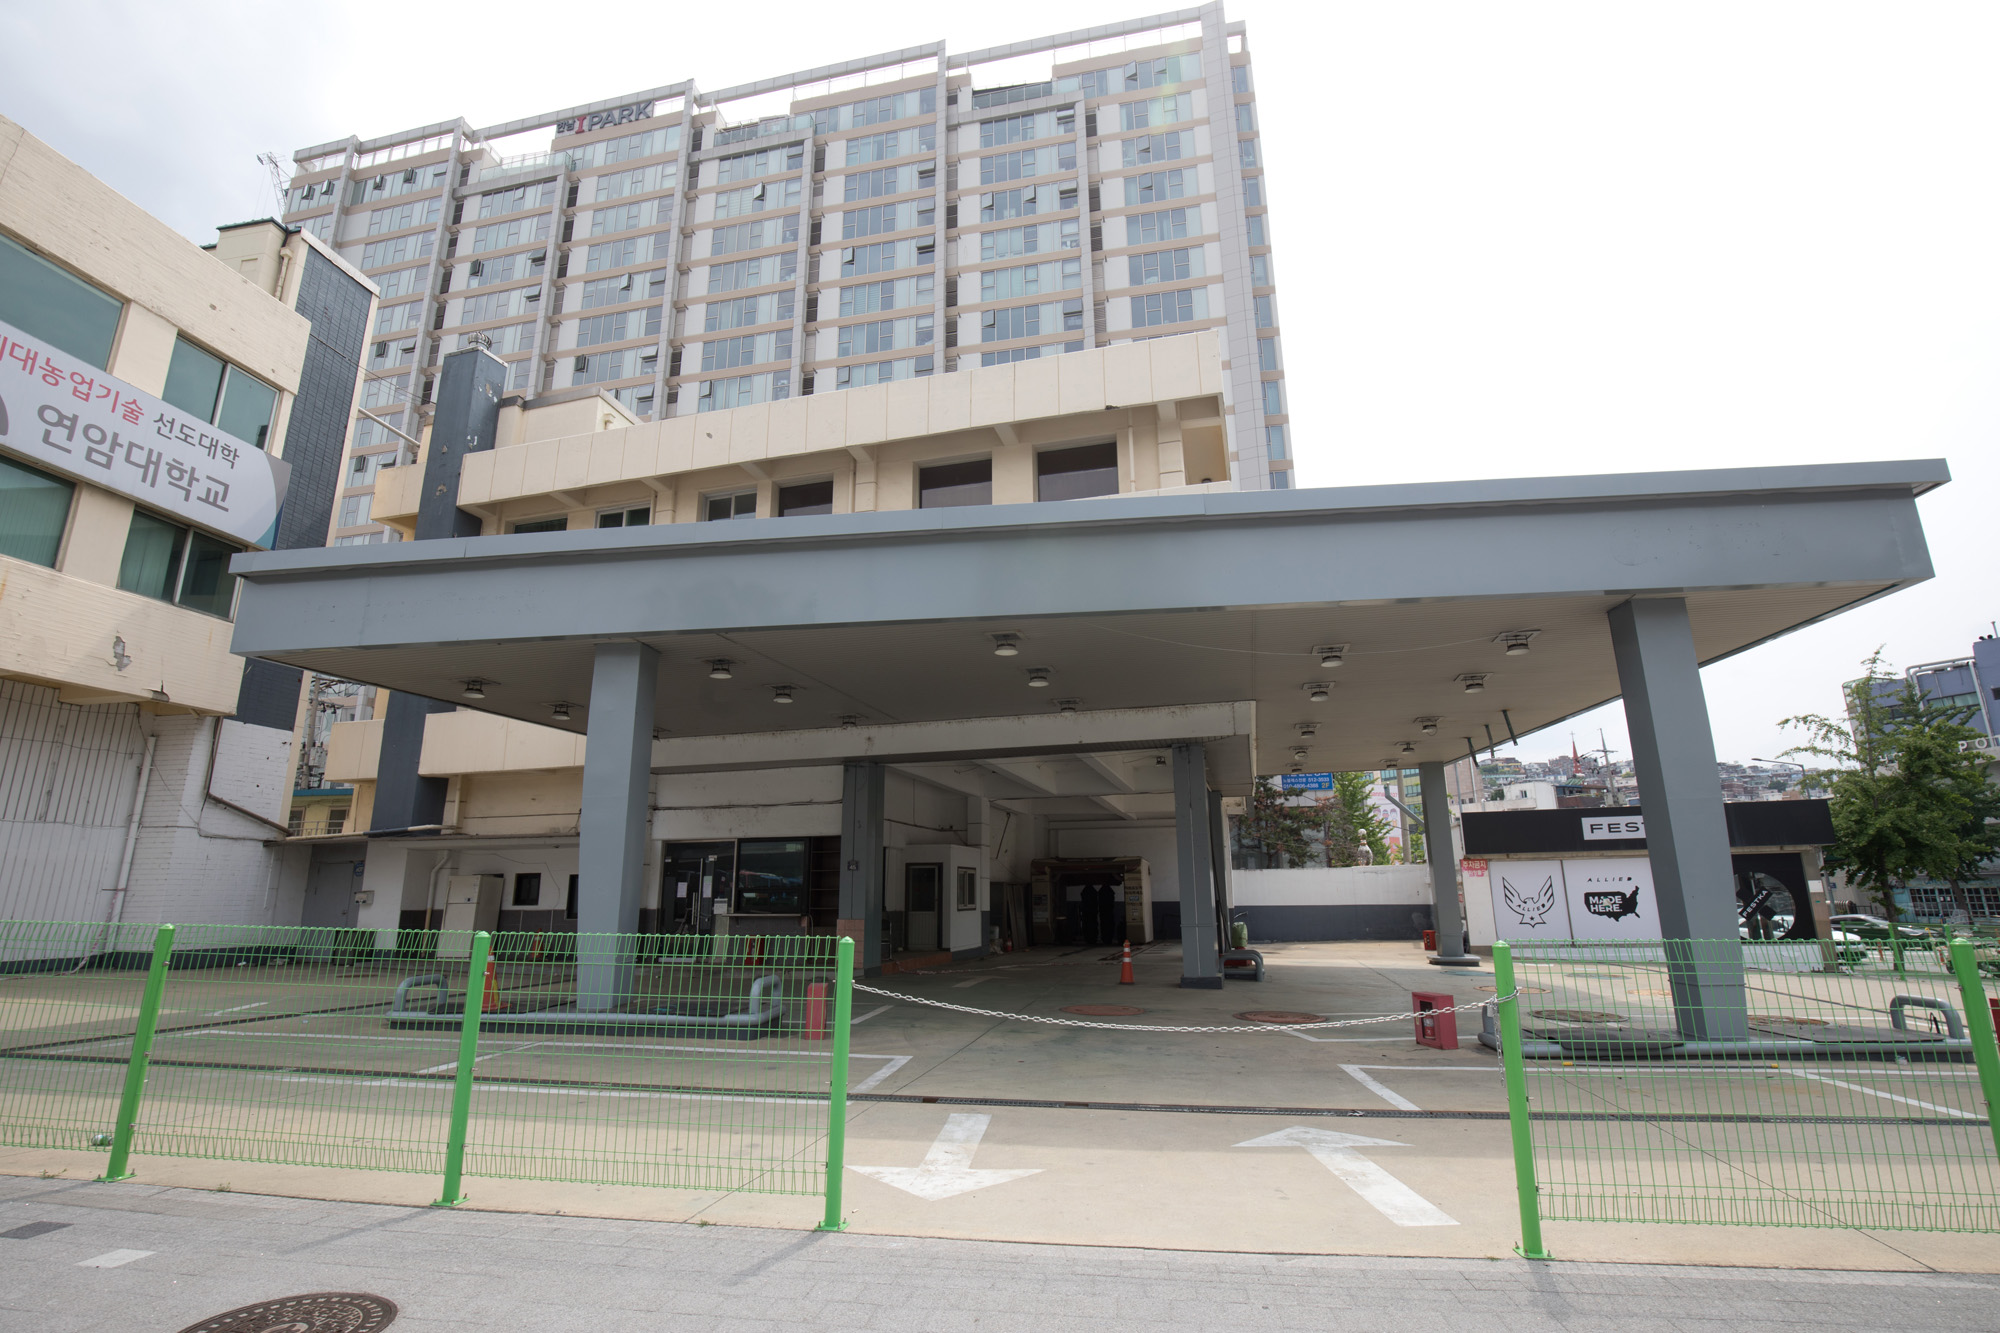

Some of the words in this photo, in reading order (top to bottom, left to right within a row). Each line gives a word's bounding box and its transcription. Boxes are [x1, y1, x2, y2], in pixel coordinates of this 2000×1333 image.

[153, 412, 240, 469] 선도대학
[37, 404, 230, 512] 연암대학교
[1590, 822, 1645, 834] FES
[1463, 860, 1487, 870] 주차금지
[1742, 890, 1769, 917] FESTKA
